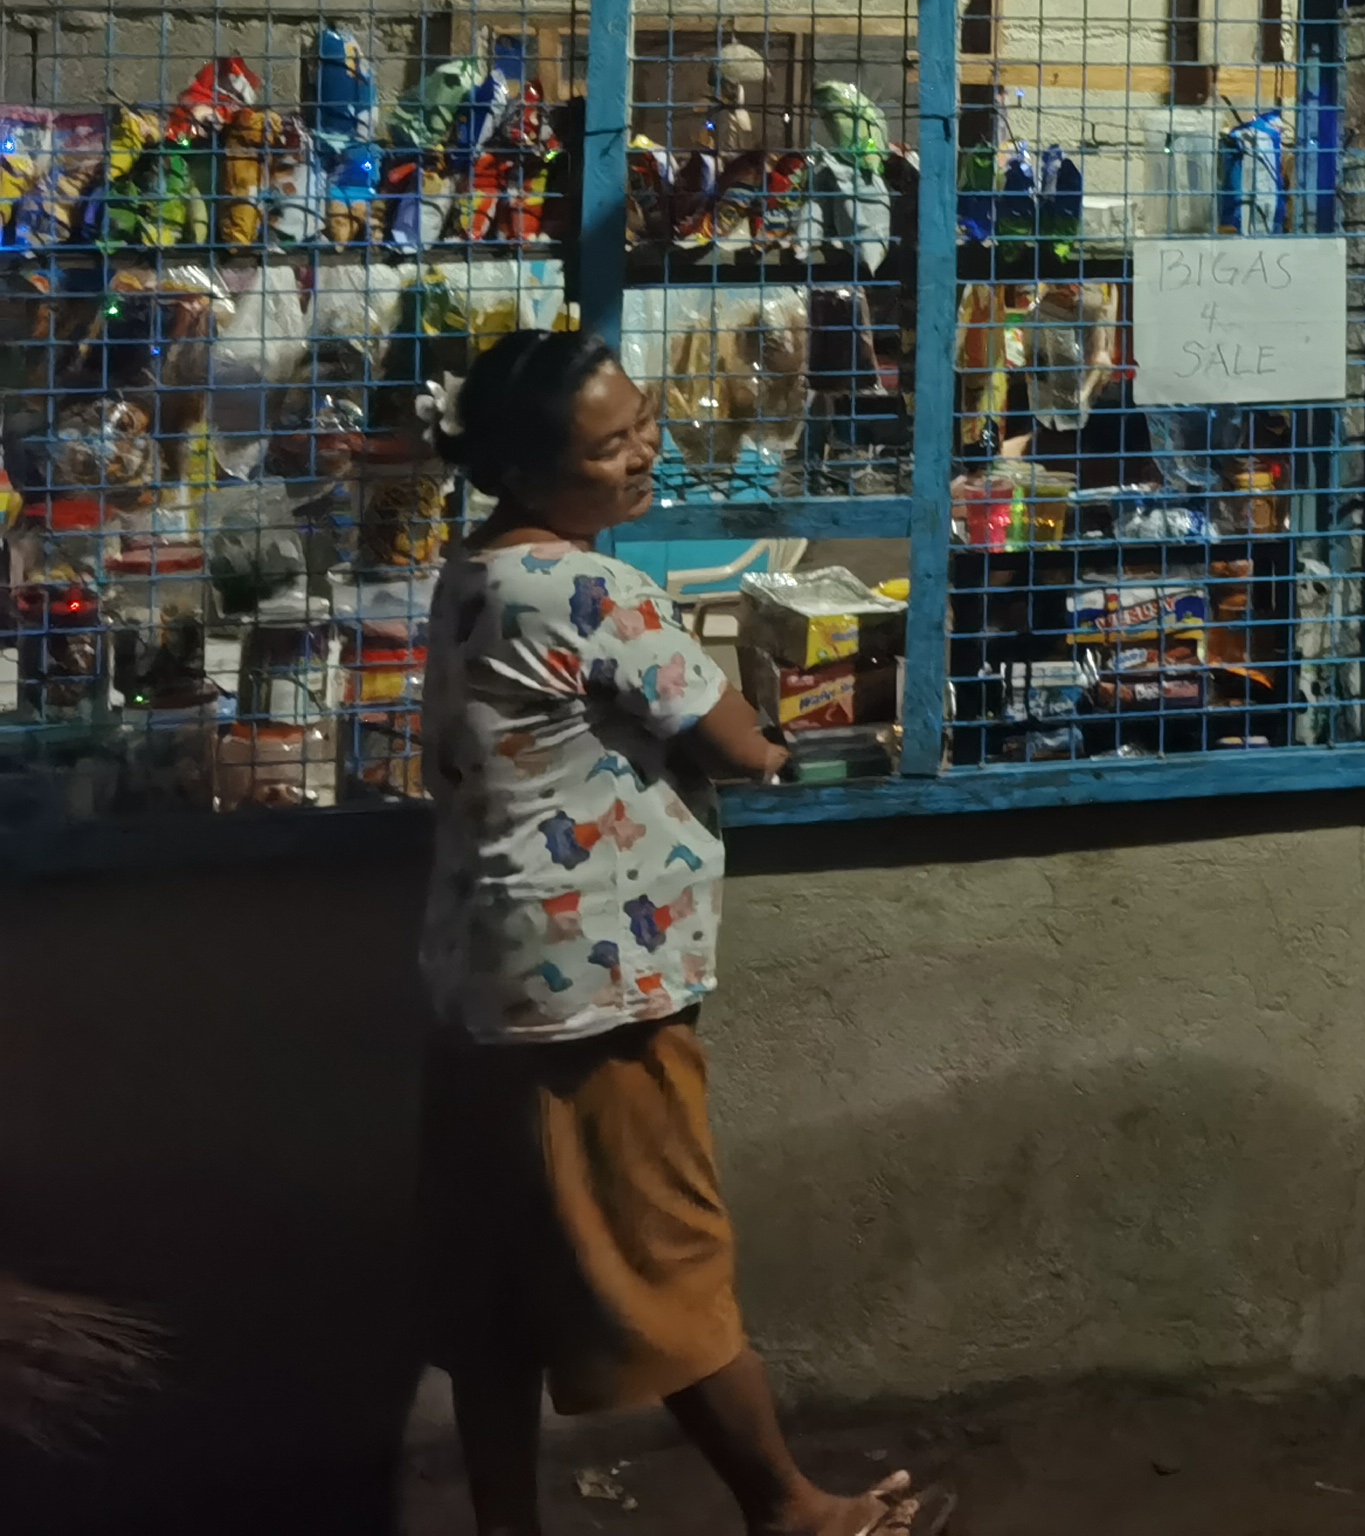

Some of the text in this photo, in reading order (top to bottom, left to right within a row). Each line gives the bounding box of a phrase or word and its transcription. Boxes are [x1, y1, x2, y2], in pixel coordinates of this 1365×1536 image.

[1159, 248, 1292, 292] BIGAS
[1200, 302, 1218, 333] 4
[1173, 340, 1277, 378] SALE
